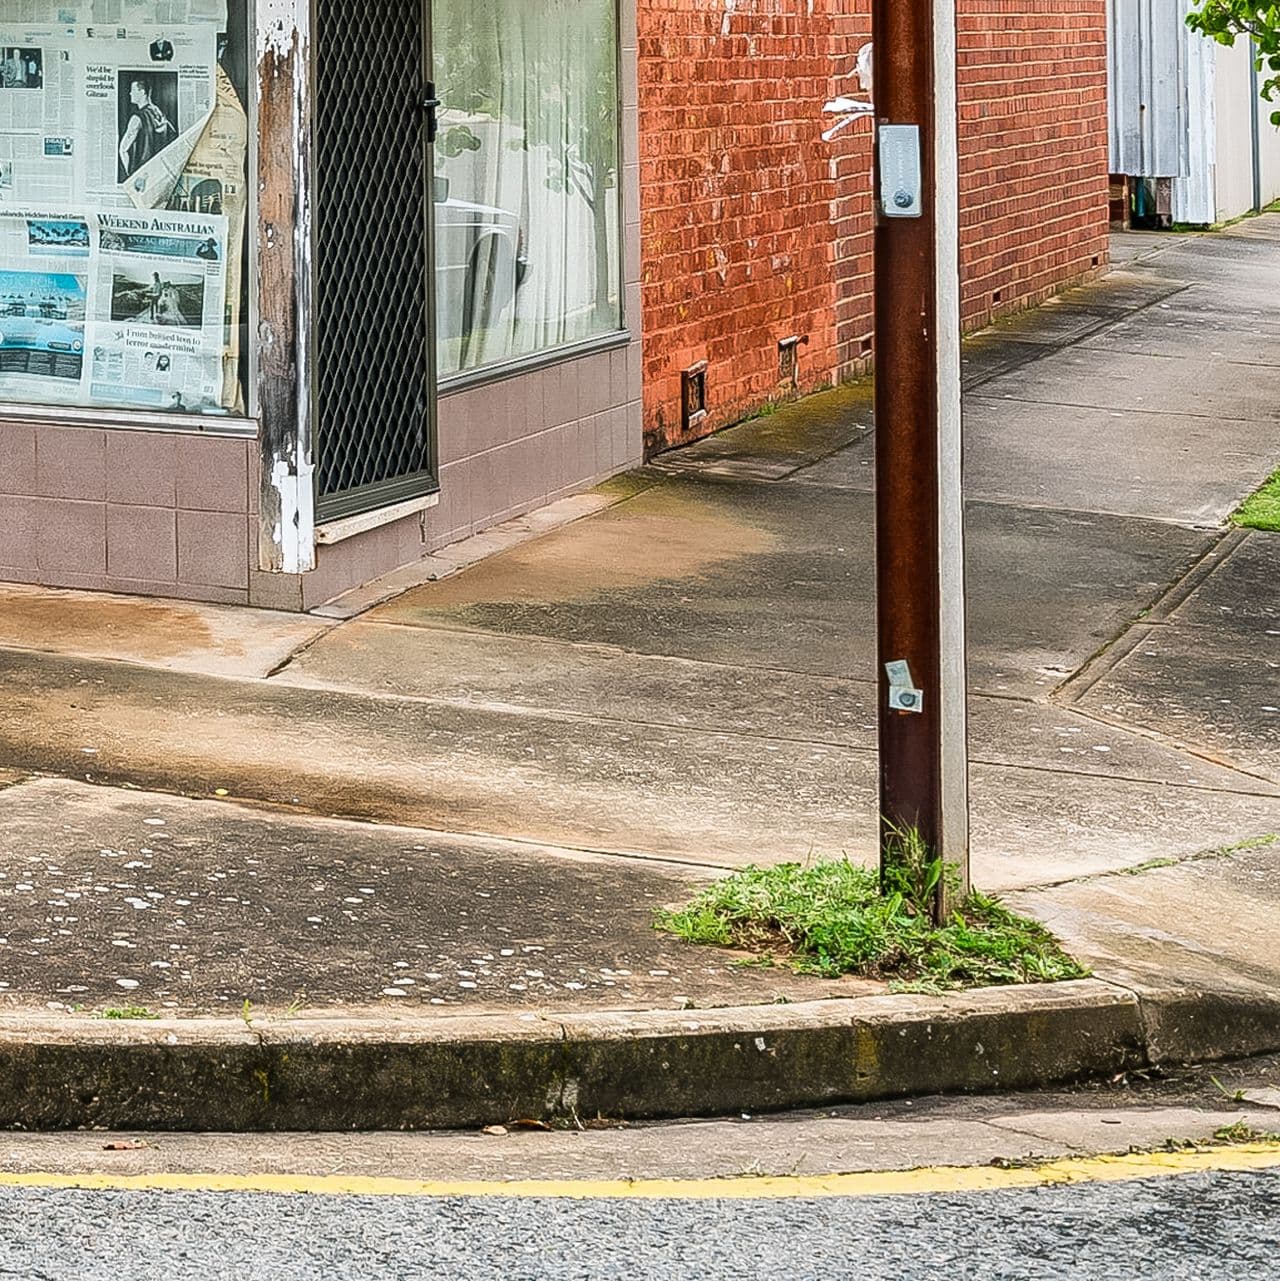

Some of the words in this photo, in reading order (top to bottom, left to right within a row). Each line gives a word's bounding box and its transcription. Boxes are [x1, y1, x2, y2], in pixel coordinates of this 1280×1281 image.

[25, 211, 48, 219] Hidden
[48, 212, 68, 220] Island
[97, 214, 149, 230] WEEKEND
[151, 218, 216, 235] AUSTRALIAN
[126, 338, 149, 348] terror
